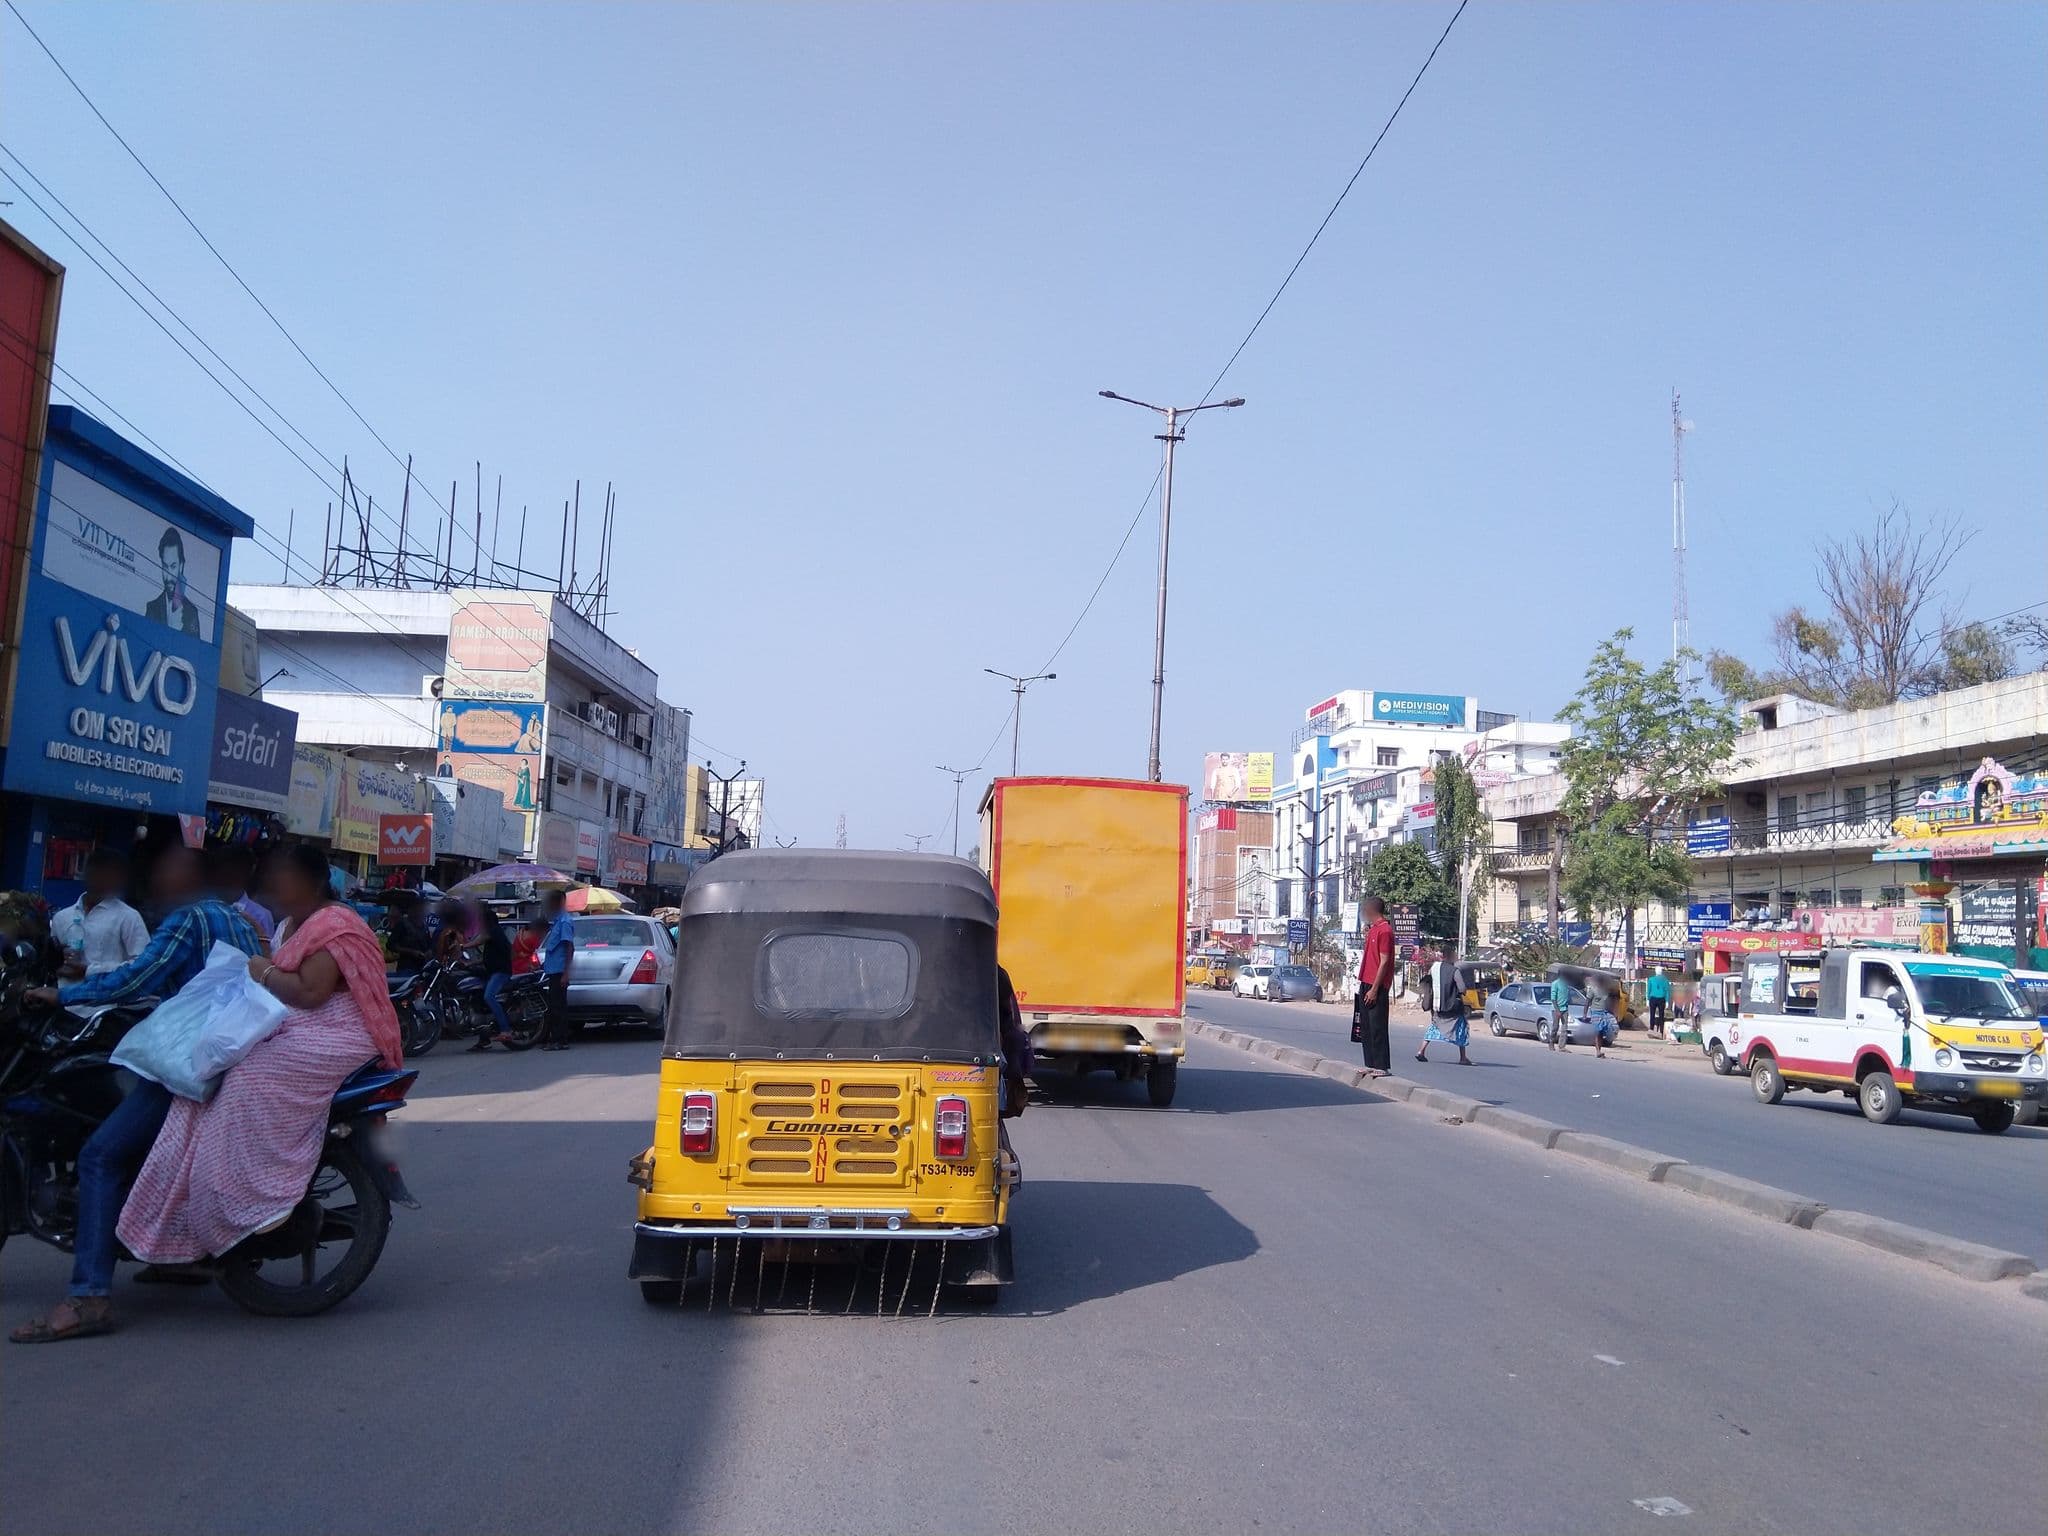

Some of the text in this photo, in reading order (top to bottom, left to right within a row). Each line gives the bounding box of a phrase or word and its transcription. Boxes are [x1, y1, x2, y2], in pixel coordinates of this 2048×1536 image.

[1392, 700, 1450, 711] MEDIVISION
[70, 707, 172, 756] OM SRI SAI
[221, 723, 280, 768] safari
[46, 741, 102, 767] MOBILES
[112, 755, 184, 784] ELECTRONICS
[383, 847, 425, 855] WILDCRAFT
[1820, 911, 1885, 935] MRF
[1976, 1034, 1997, 1043] MOTOR
[920, 1163, 947, 1175] TS34
[956, 1165, 975, 1177] 395
